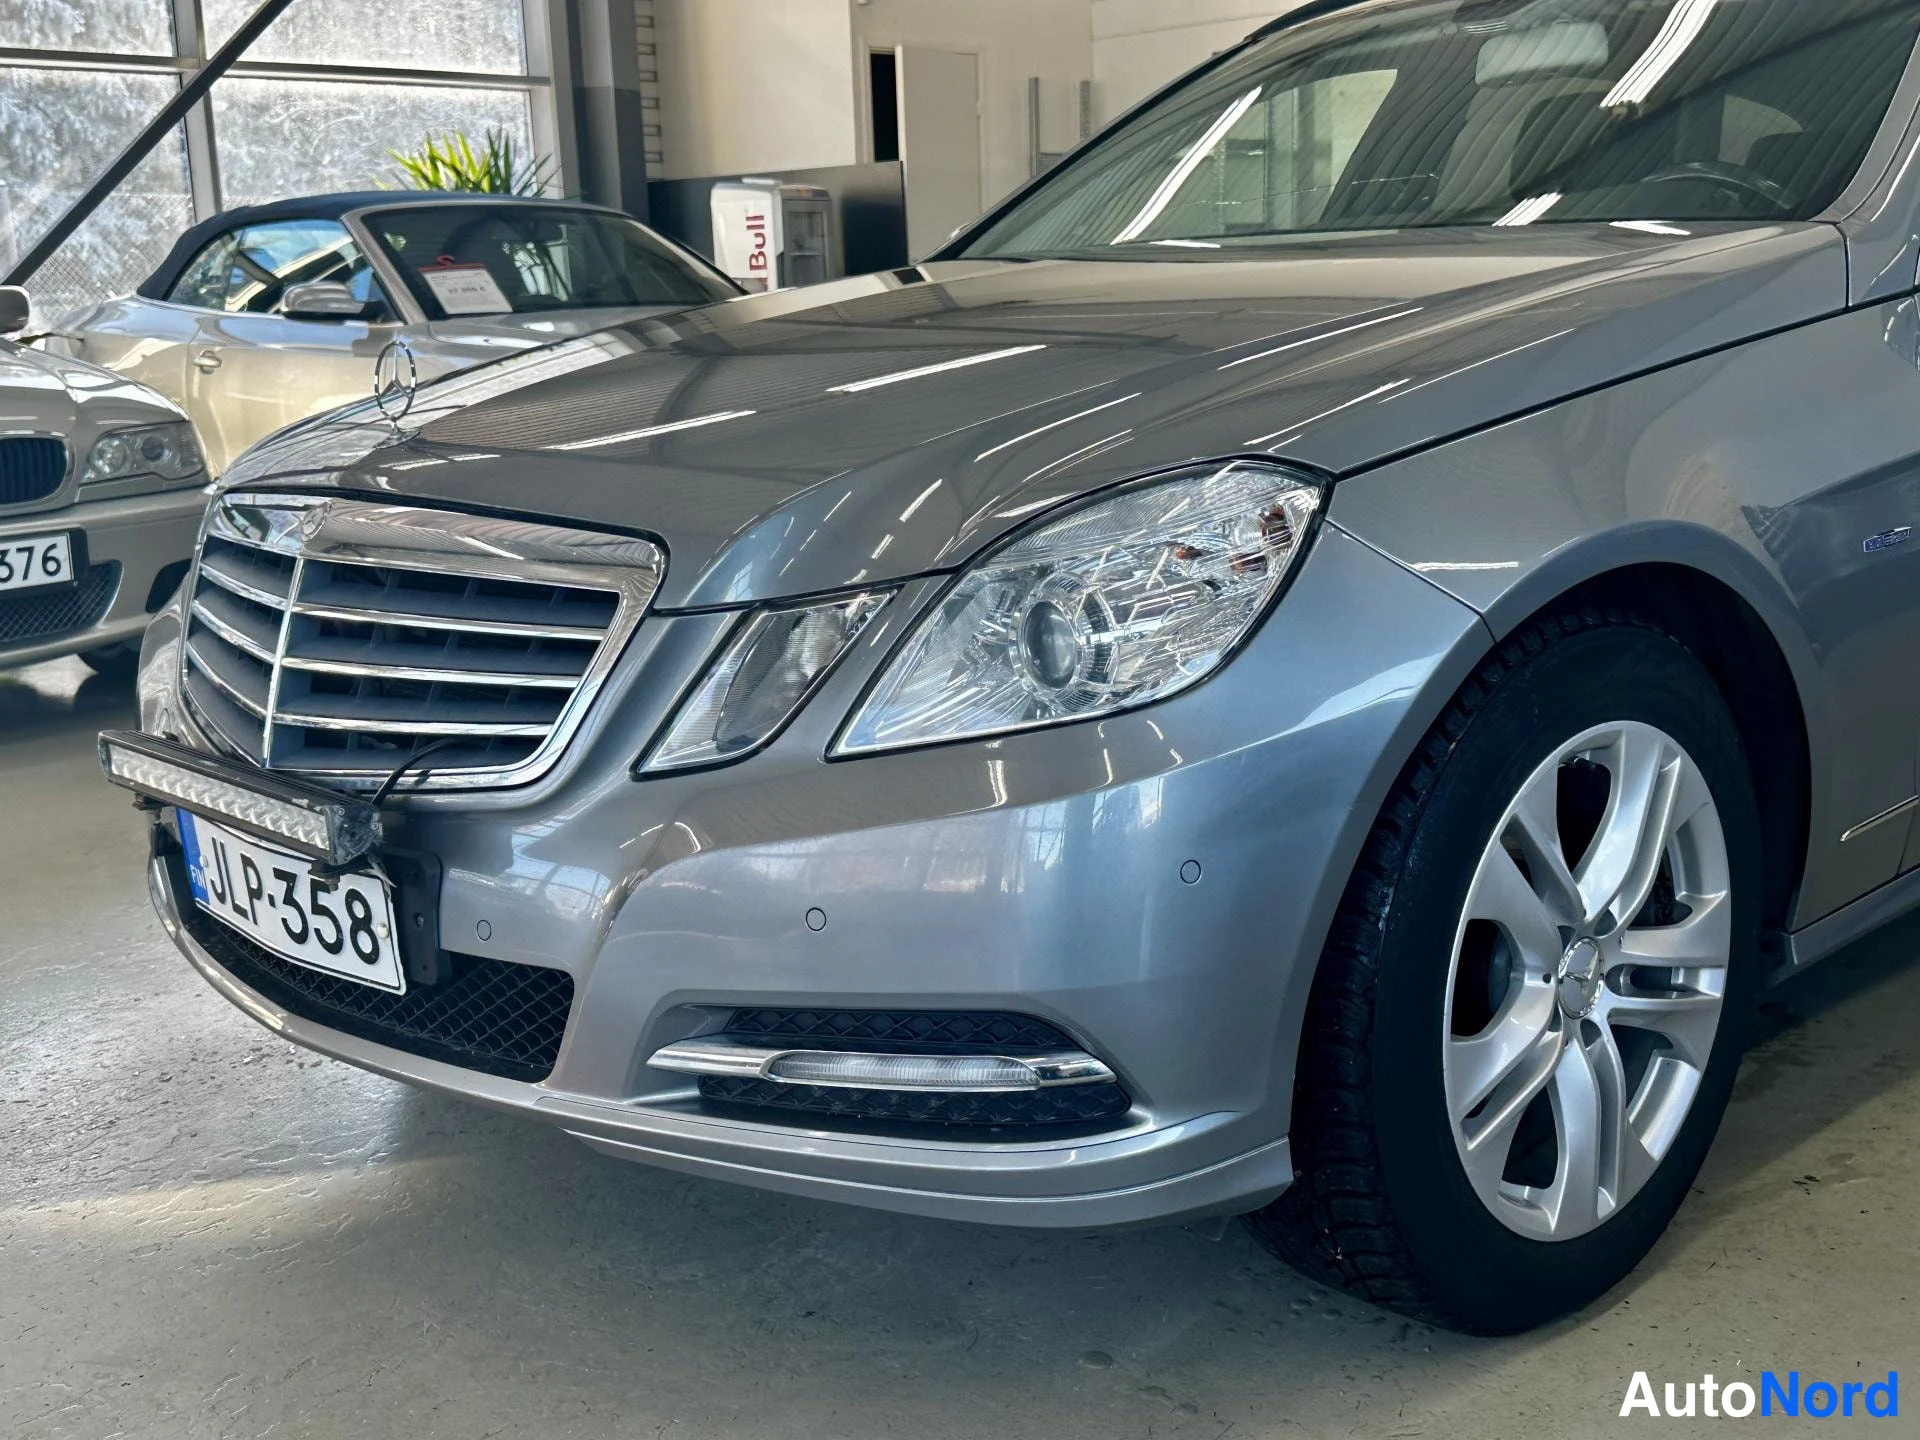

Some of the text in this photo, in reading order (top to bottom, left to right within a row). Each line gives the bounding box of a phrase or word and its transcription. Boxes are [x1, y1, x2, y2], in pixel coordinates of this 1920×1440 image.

[745, 215, 768, 271] Bull
[0, 543, 61, 583] 376
[210, 836, 380, 965] JLP-358
